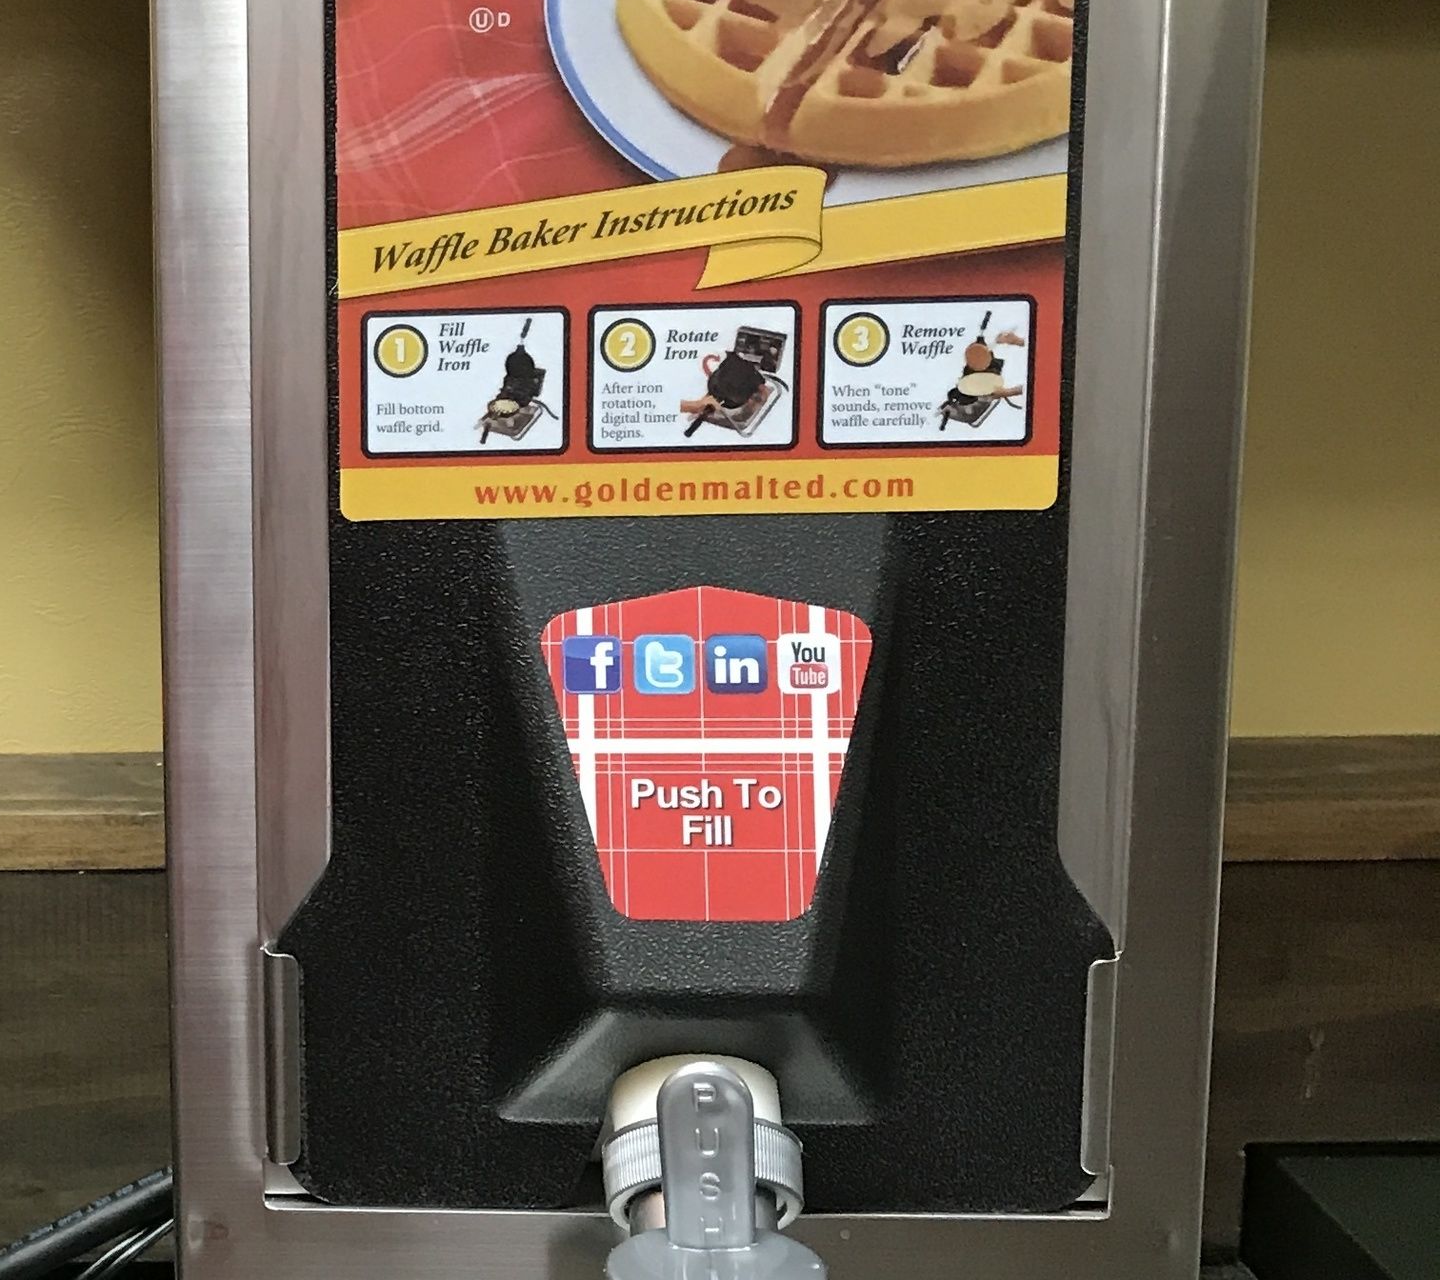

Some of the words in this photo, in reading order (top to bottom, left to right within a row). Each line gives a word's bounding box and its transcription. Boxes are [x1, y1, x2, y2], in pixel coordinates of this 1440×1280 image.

[372, 231, 480, 275] Waffle
[485, 218, 588, 256] Baker
[590, 188, 798, 240] Instructions
[438, 322, 466, 337] Fill
[666, 329, 719, 343] Rotate
[902, 324, 966, 338] Remove
[620, 331, 637, 357] 2
[852, 326, 869, 352] 3
[394, 337, 407, 364] 1
[438, 339, 490, 358] Waffle
[663, 347, 699, 360] Iron
[901, 340, 954, 360] Waffle
[437, 358, 471, 371] Iron
[601, 383, 634, 394] After
[637, 383, 663, 394] iron
[832, 385, 871, 397] When
[376, 403, 397, 415] Fill
[399, 403, 445, 415] bottom
[601, 398, 656, 410] rotation,
[831, 400, 880, 412] sounds,
[884, 402, 932, 411] remove
[601, 412, 641, 426] digital
[643, 412, 678, 424] timer
[832, 414, 868, 427] waffle
[375, 420, 413, 433] waffle
[415, 420, 444, 435] grid.
[601, 427, 645, 441] begins.
[474, 471, 915, 509] www.goldenmalted.com
[713, 645, 760, 684] in
[791, 641, 825, 663] You
[792, 668, 827, 686] Tube
[631, 778, 724, 810] Push
[733, 778, 783, 810] To
[682, 815, 733, 846] Fill
